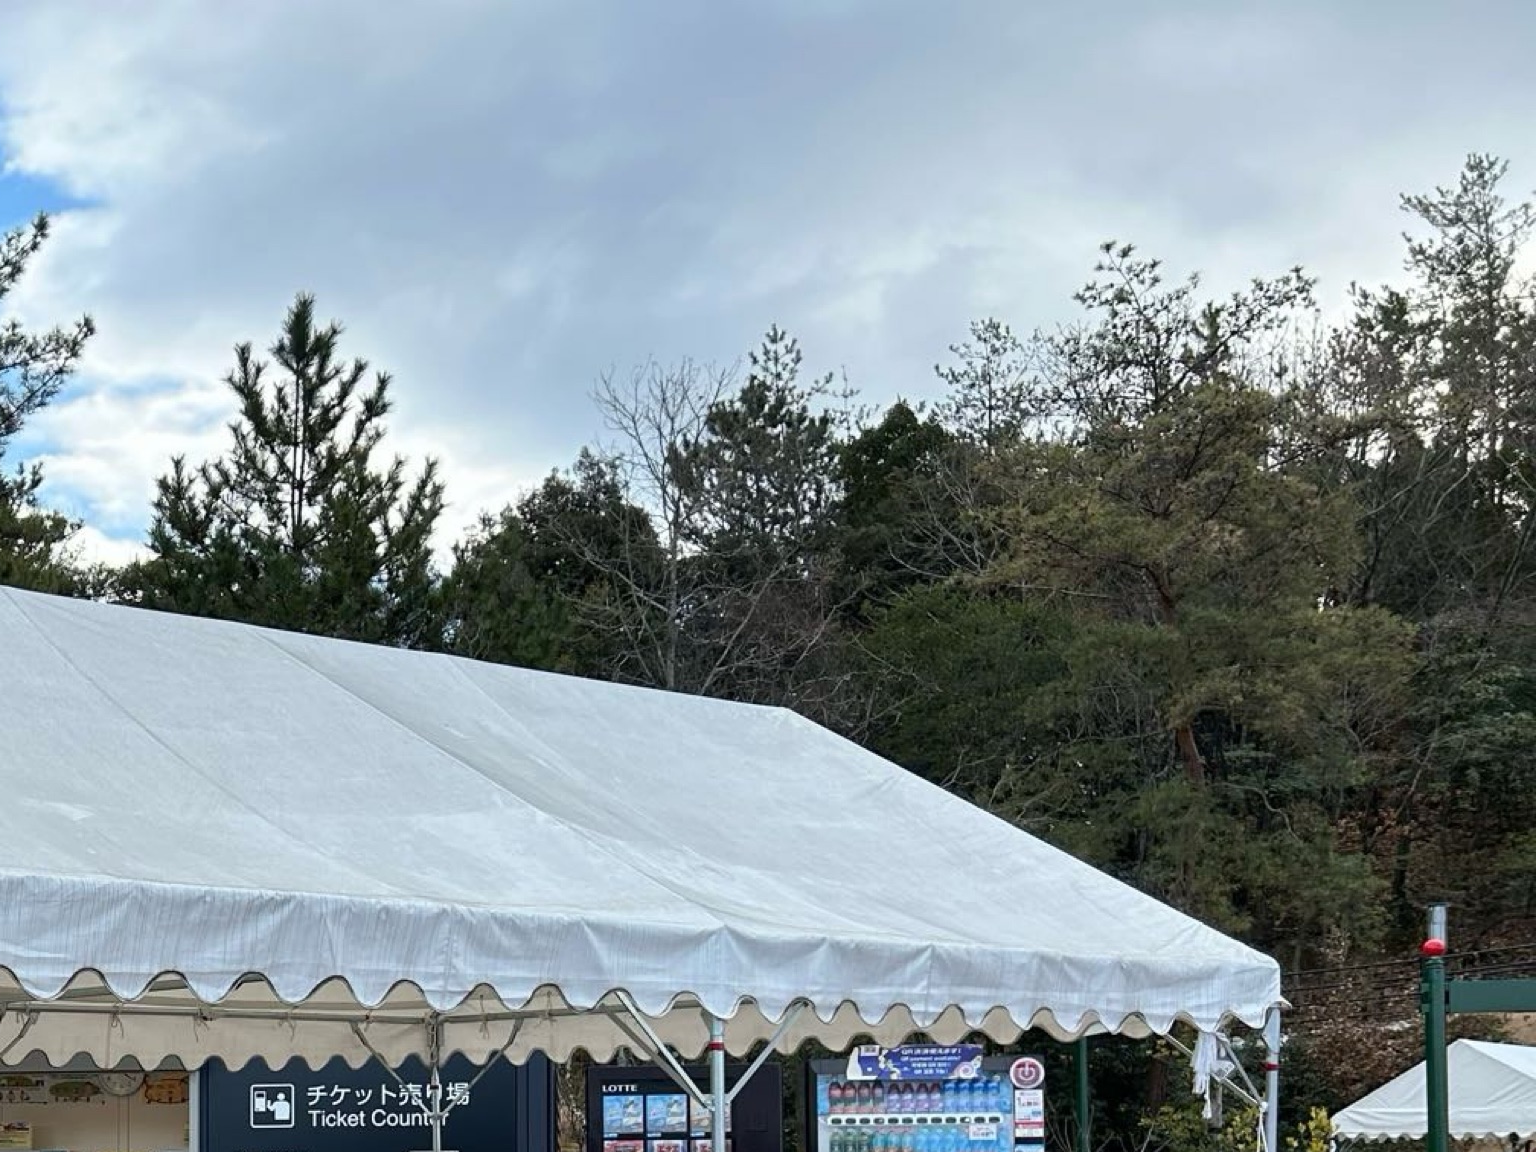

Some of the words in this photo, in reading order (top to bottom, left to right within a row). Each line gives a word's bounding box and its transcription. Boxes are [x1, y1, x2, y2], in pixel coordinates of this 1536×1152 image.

[602, 1084, 638, 1092] LOTTE
[308, 1109, 366, 1127] Ticket
[371, 1109, 449, 1127] Countr
